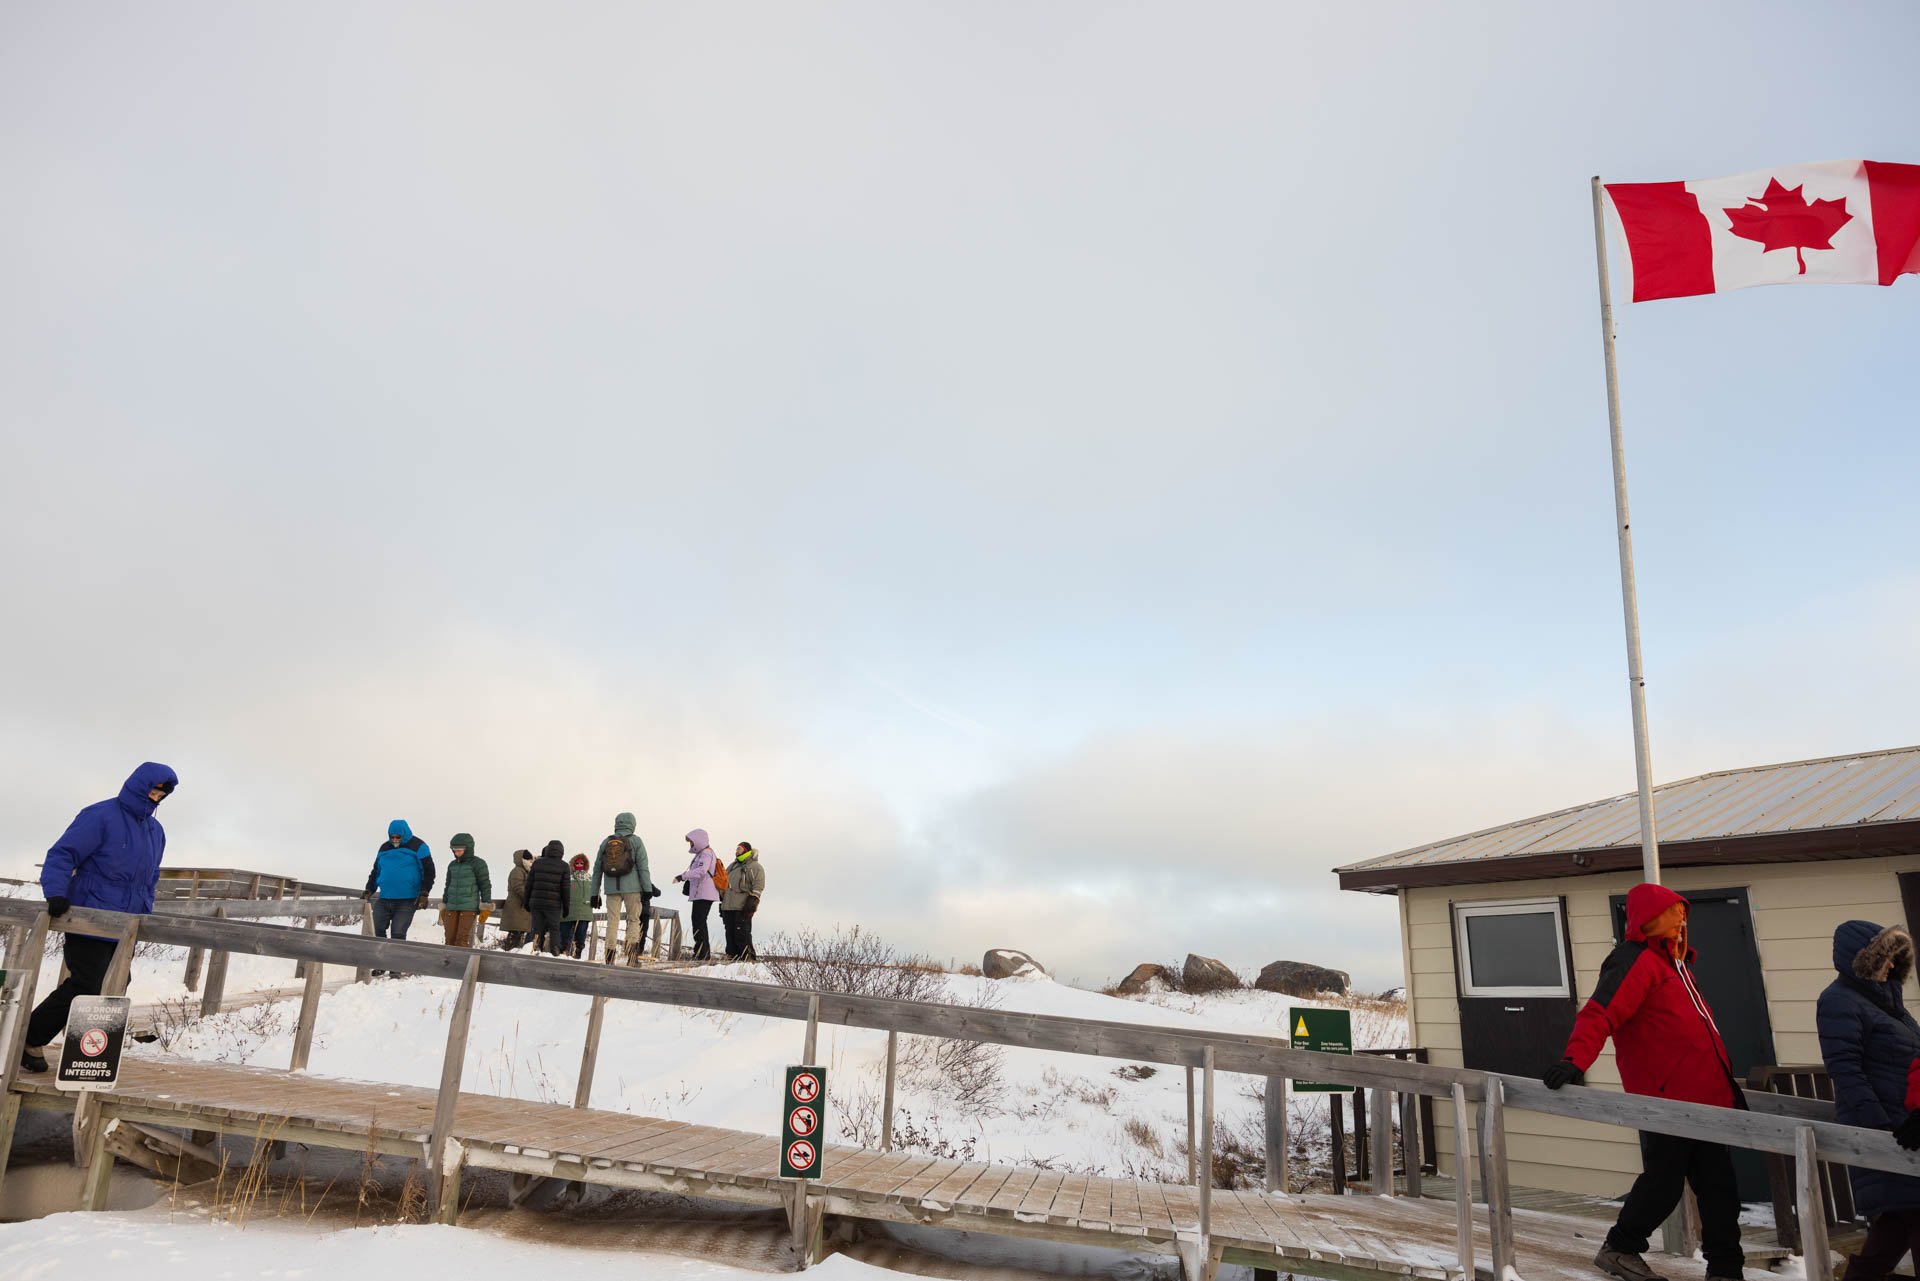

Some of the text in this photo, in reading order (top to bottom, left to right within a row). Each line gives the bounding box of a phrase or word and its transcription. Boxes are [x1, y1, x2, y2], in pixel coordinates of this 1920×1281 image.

[93, 1006, 123, 1014] DRONE
[72, 1061, 108, 1069] DRONES
[65, 1069, 111, 1077] INTERDITS
